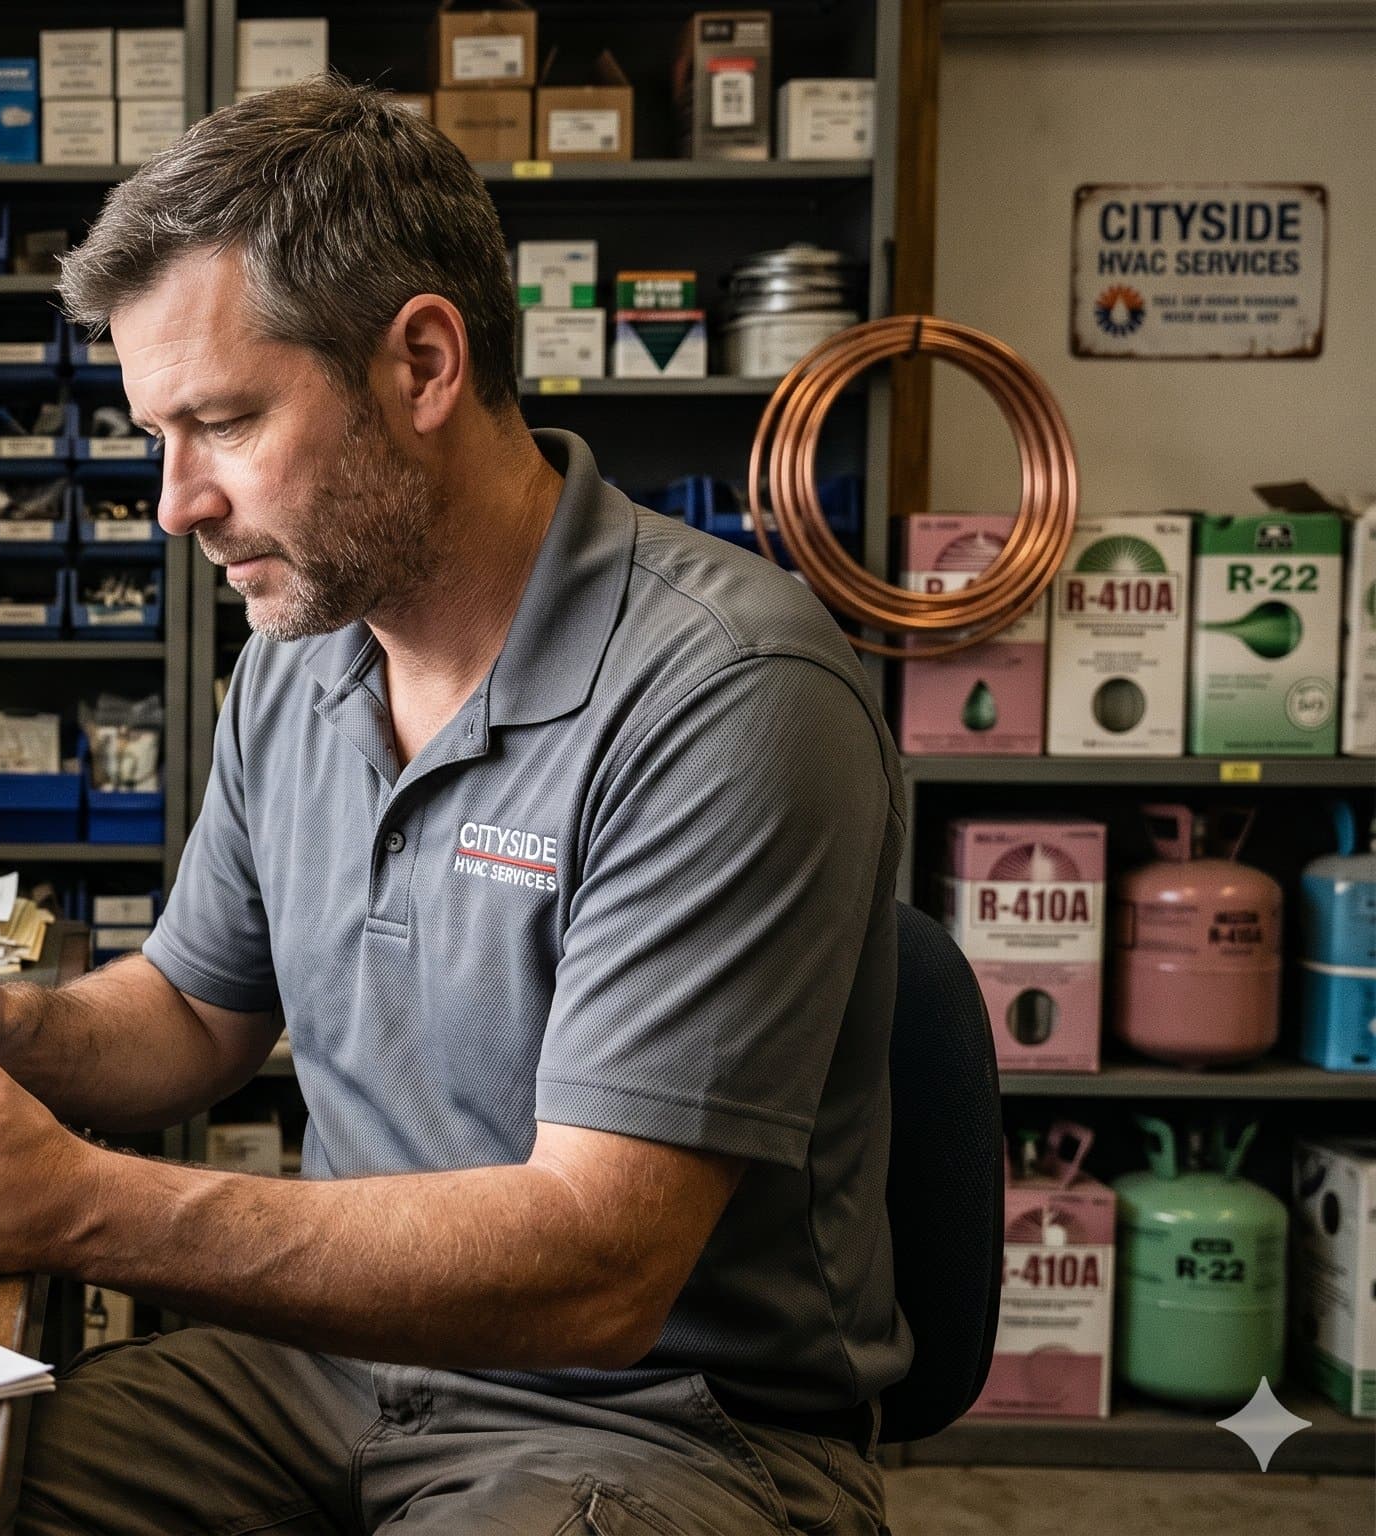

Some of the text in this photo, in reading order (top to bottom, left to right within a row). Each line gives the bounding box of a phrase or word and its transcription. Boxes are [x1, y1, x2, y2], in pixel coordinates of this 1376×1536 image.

[1100, 202, 1301, 243] CITYSIDE
[1099, 249, 1300, 276] HVAC SERVICES
[1227, 564, 1319, 593] R-22
[1065, 579, 1175, 613] R-410A
[460, 822, 557, 863] CITYSIDE
[454, 855, 556, 891] HVAC SERVICES
[978, 888, 1090, 922] R-410A
[1176, 1256, 1245, 1282] R-22
